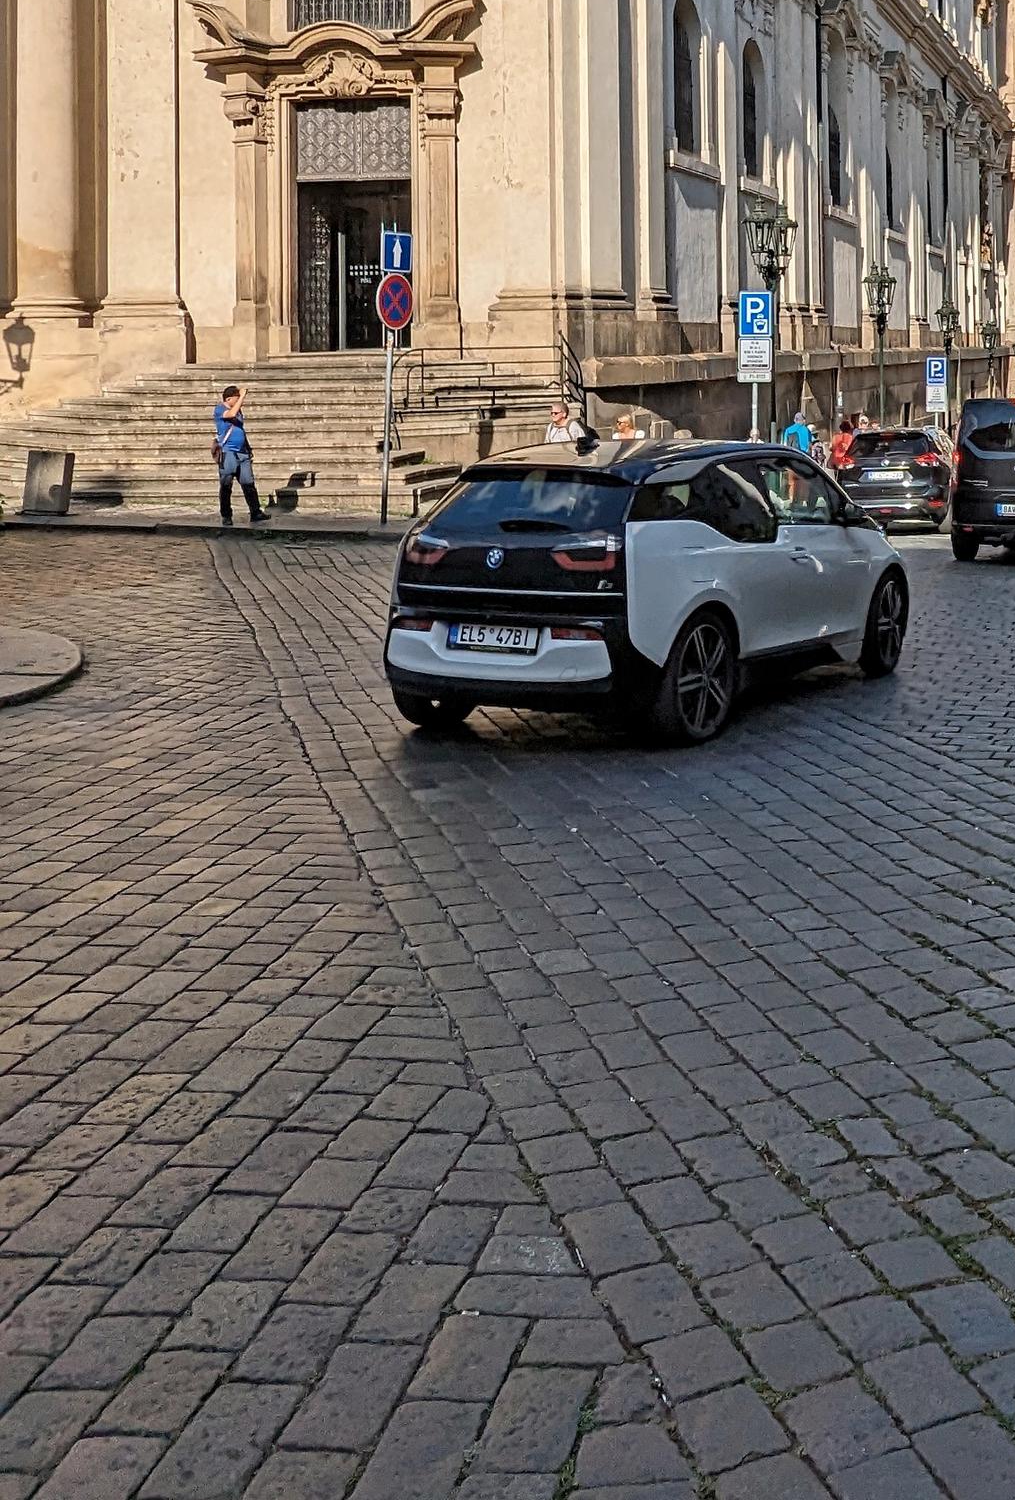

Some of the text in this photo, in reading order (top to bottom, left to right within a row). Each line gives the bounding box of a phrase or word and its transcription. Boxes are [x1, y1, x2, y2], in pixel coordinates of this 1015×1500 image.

[746, 297, 765, 323] P
[930, 361, 943, 377] P
[460, 625, 486, 643] EL5
